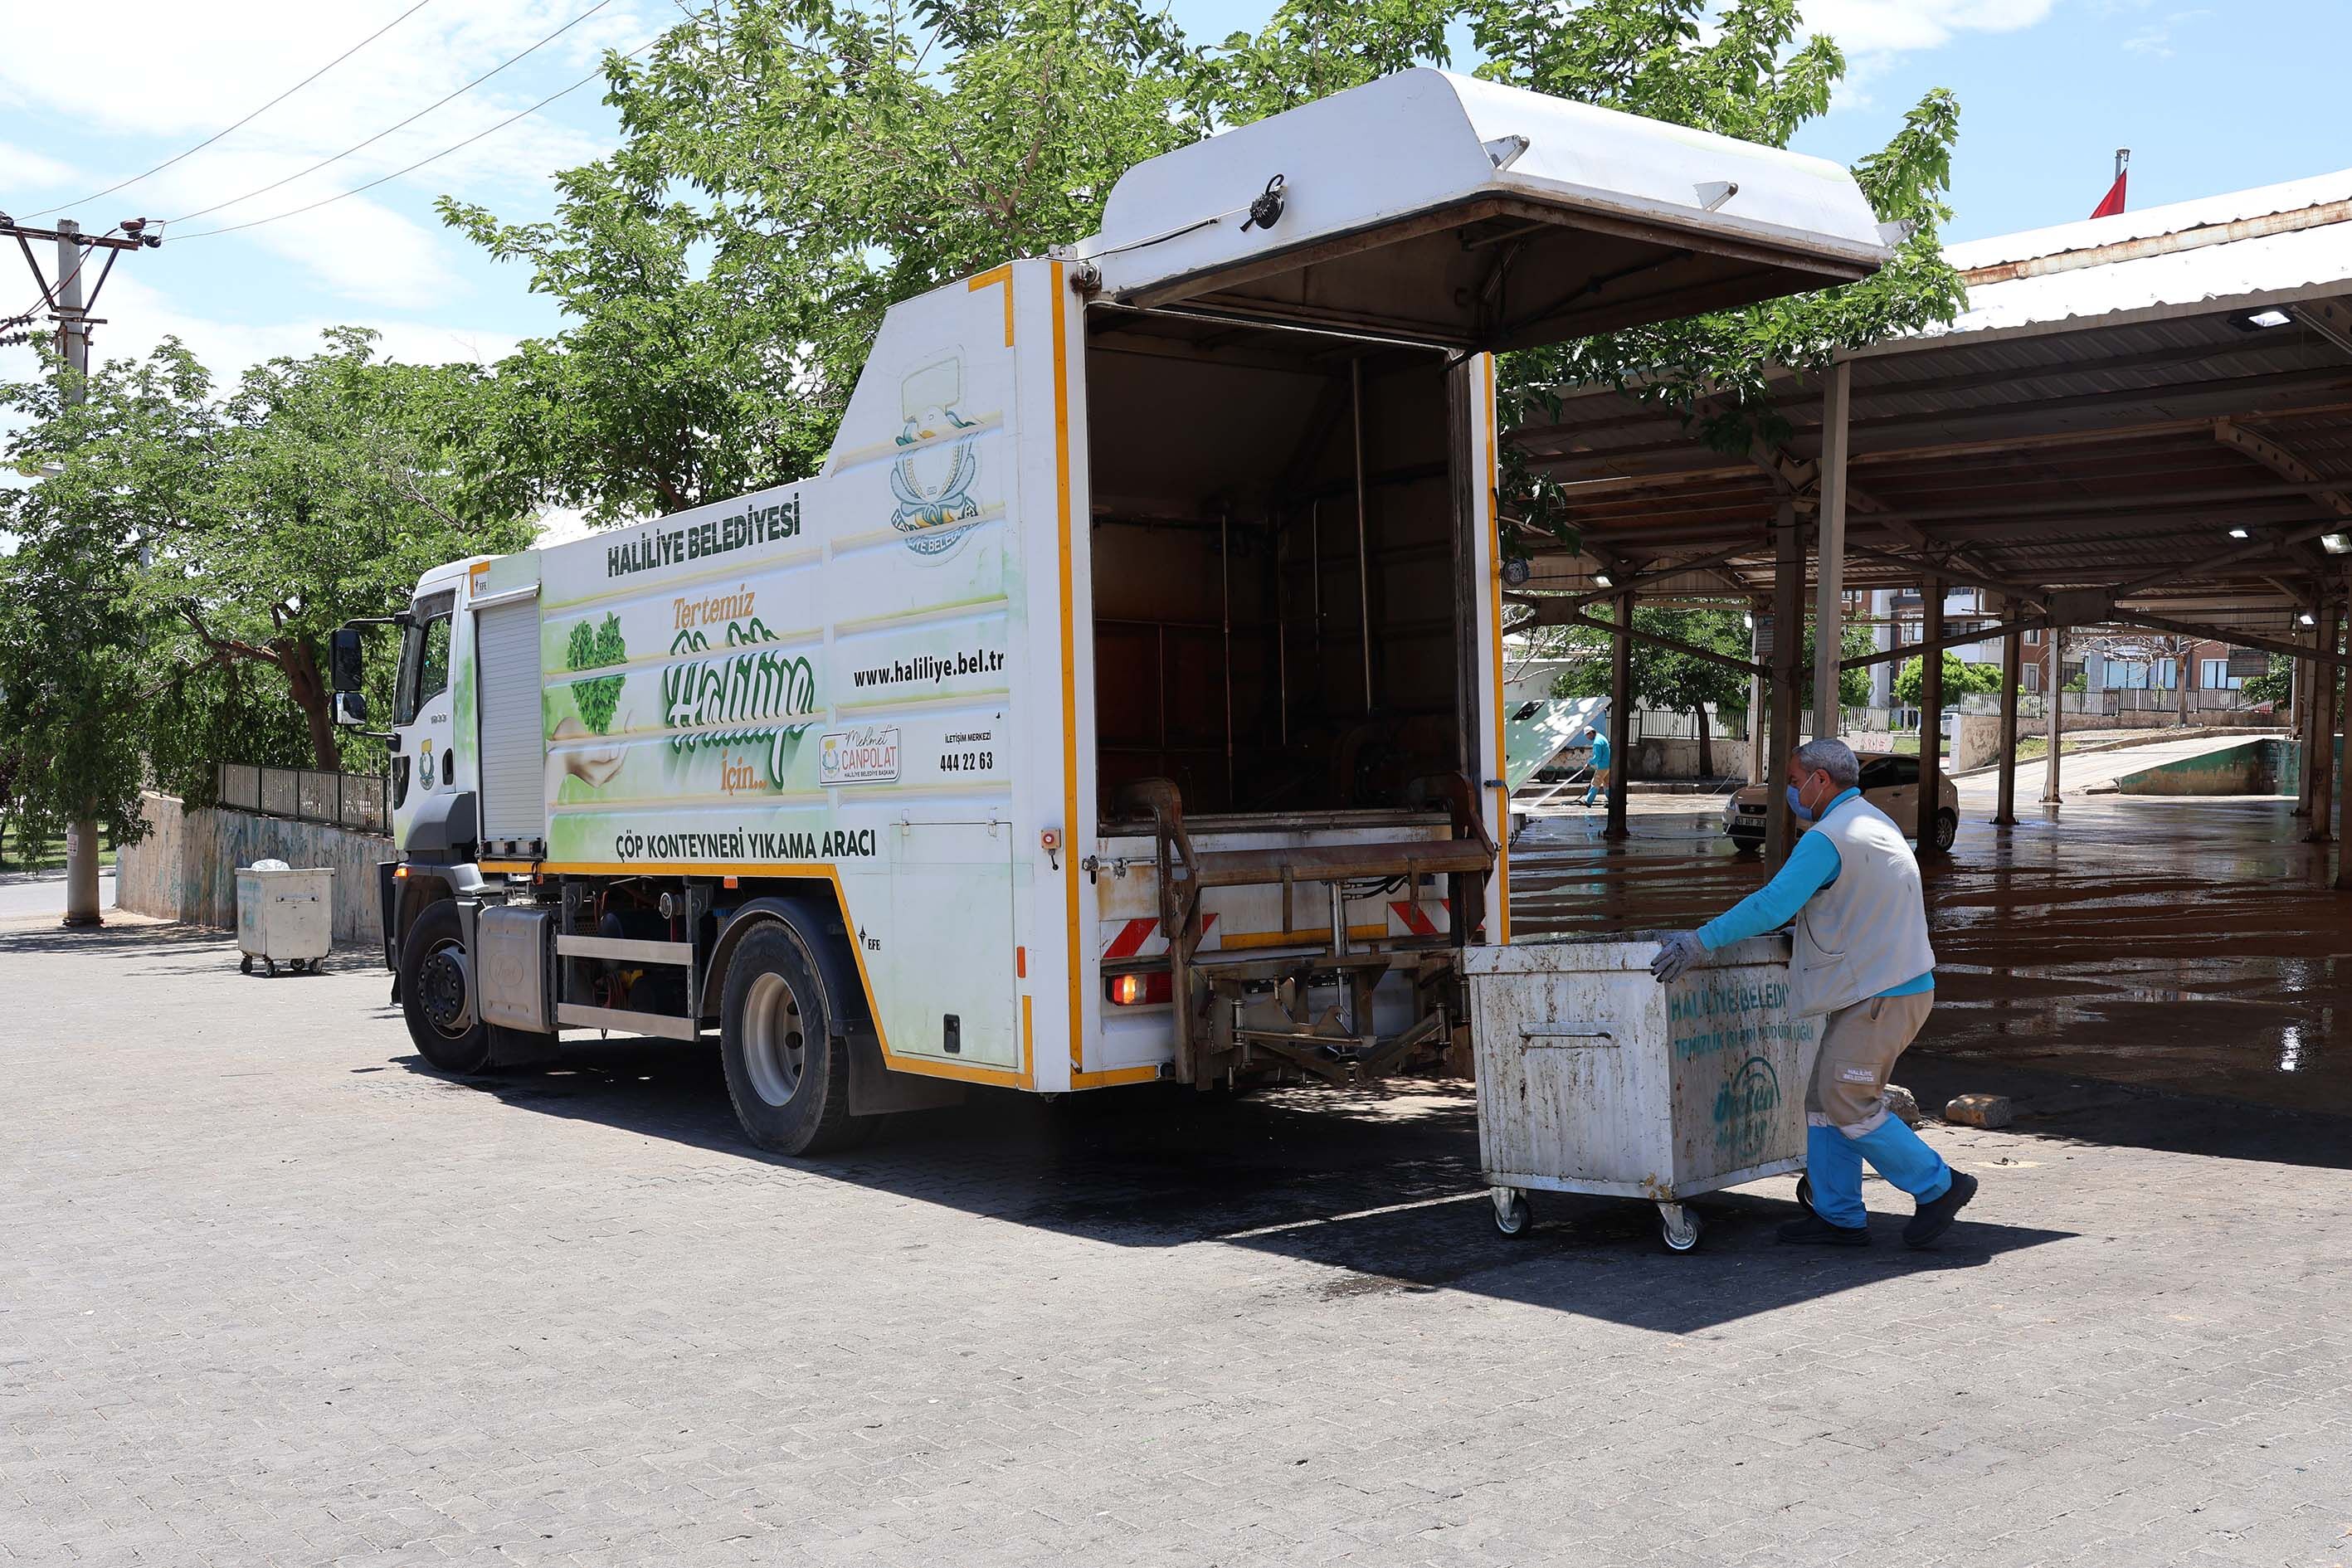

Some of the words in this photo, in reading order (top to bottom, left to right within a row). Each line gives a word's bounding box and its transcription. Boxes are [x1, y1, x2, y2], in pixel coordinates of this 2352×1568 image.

[607, 528, 684, 577] HALİLİYE
[688, 492, 801, 560] BELEDİYESİ
[674, 583, 756, 630] Tertemiz
[854, 649, 1004, 687] www.haliliye.bel.tr
[841, 746, 896, 771] CANPOLAT
[940, 753, 959, 772] 444
[962, 752, 976, 771] 22
[979, 751, 993, 770] 63
[616, 829, 643, 863] ÇÖP
[647, 826, 745, 858] KONTEYNERİ
[747, 832, 817, 859] YIKAMA
[821, 829, 876, 857] ARACI
[868, 938, 881, 951] EFE
